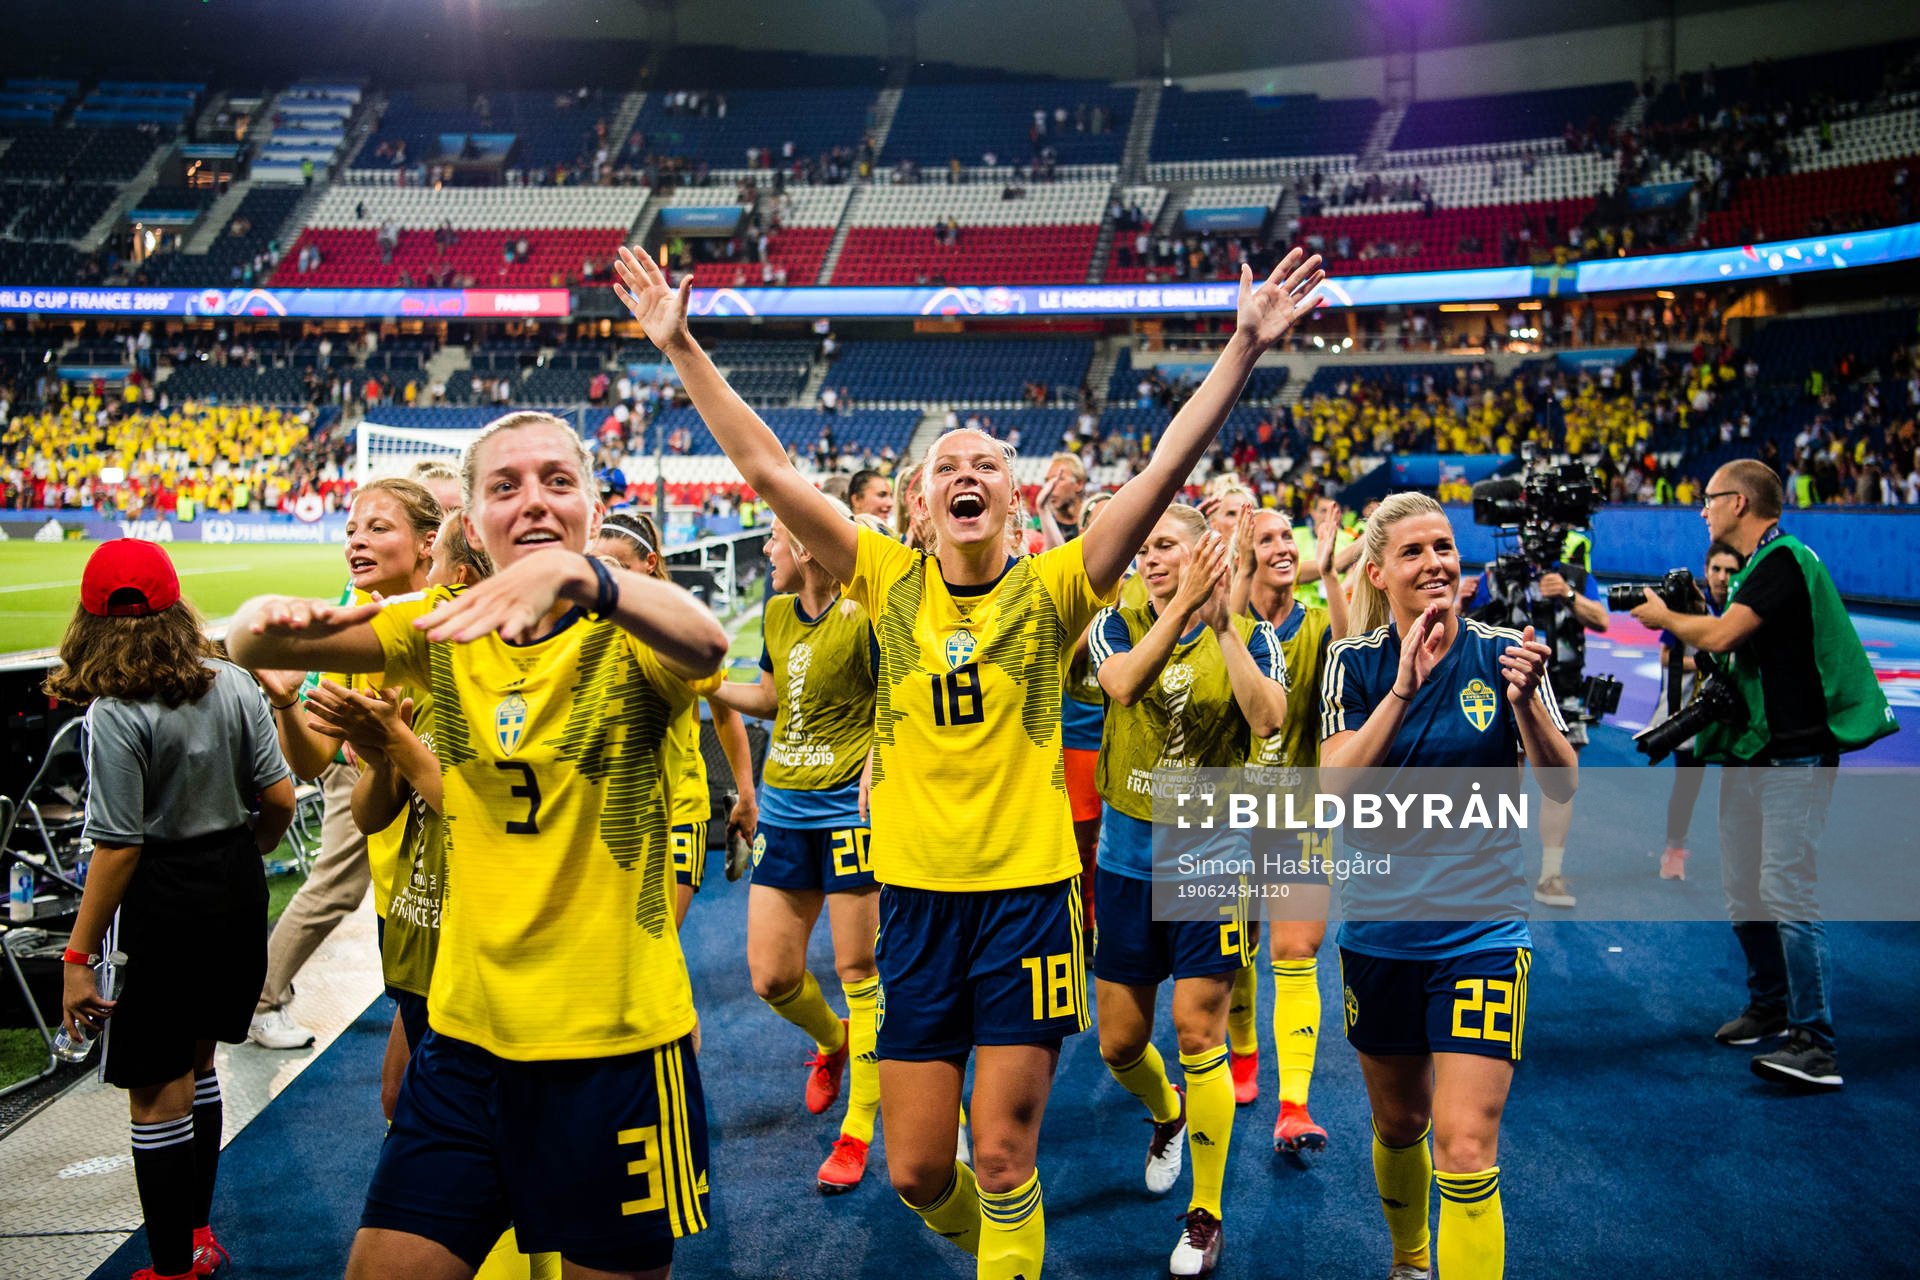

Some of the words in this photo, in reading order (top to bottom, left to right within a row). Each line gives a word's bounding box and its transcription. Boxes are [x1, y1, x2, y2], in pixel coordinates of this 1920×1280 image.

[34, 292, 68, 308] CUP
[70, 292, 131, 310] FRANCE
[1038, 292, 1061, 308] LE
[1062, 290, 1136, 308] MOMENT
[1137, 290, 1160, 307] DE
[119, 520, 173, 541] VISA
[927, 662, 984, 726] 18
[804, 752, 834, 766] 2019
[1163, 758, 1183, 768] FIFA
[495, 761, 541, 835] 3
[1127, 775, 1184, 799] FRANCE
[1187, 781, 1216, 798] 2019
[832, 828, 874, 876] 20
[391, 896, 428, 927] FRANCE
[1219, 905, 1239, 956] 2
[1021, 952, 1075, 1020] 18
[1451, 978, 1513, 1042] 22
[617, 1125, 665, 1216] 3
